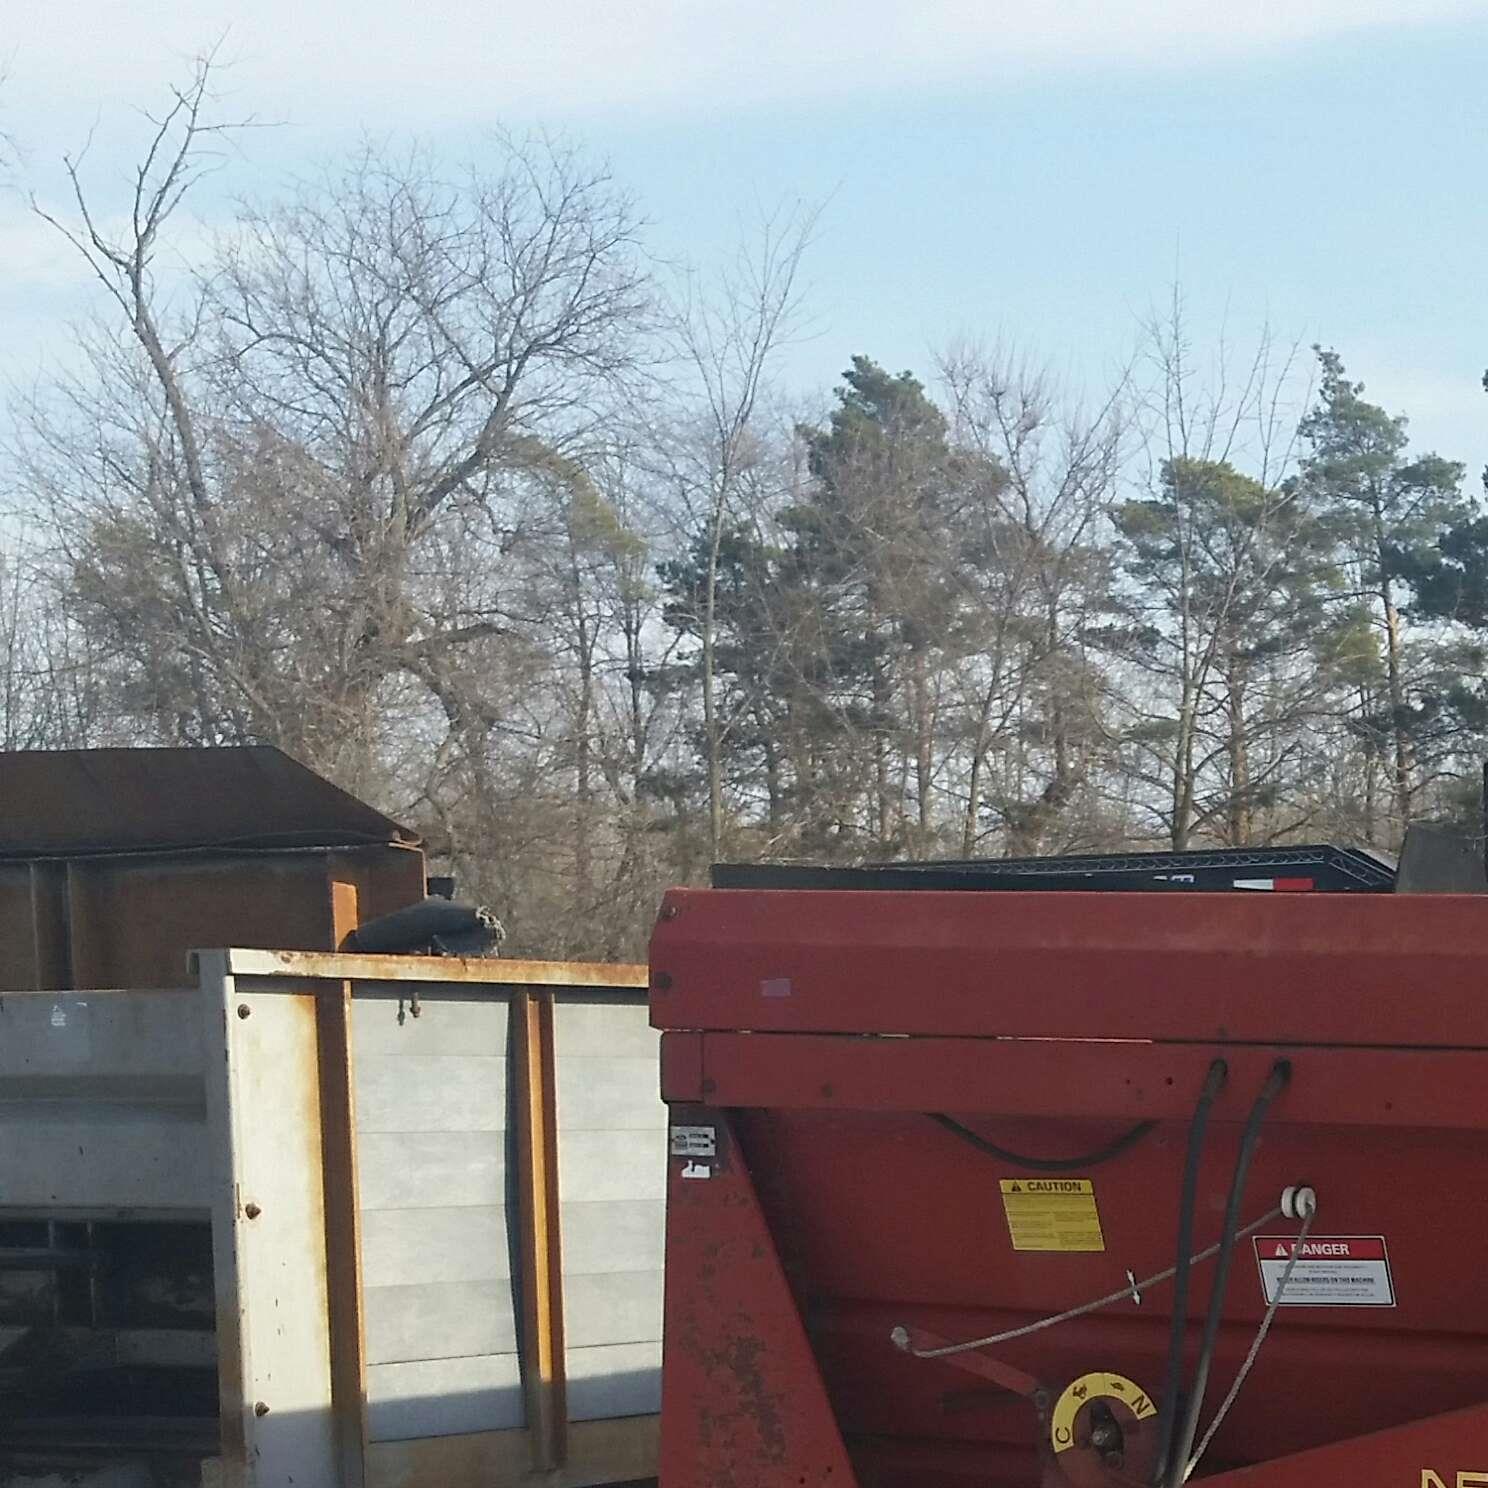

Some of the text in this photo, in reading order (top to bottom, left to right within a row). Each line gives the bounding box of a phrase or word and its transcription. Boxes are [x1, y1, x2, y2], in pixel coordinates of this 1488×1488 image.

[1027, 1181, 1082, 1192] CAUTION
[1131, 1394, 1150, 1415] N
[1055, 1426, 1070, 1444] C
